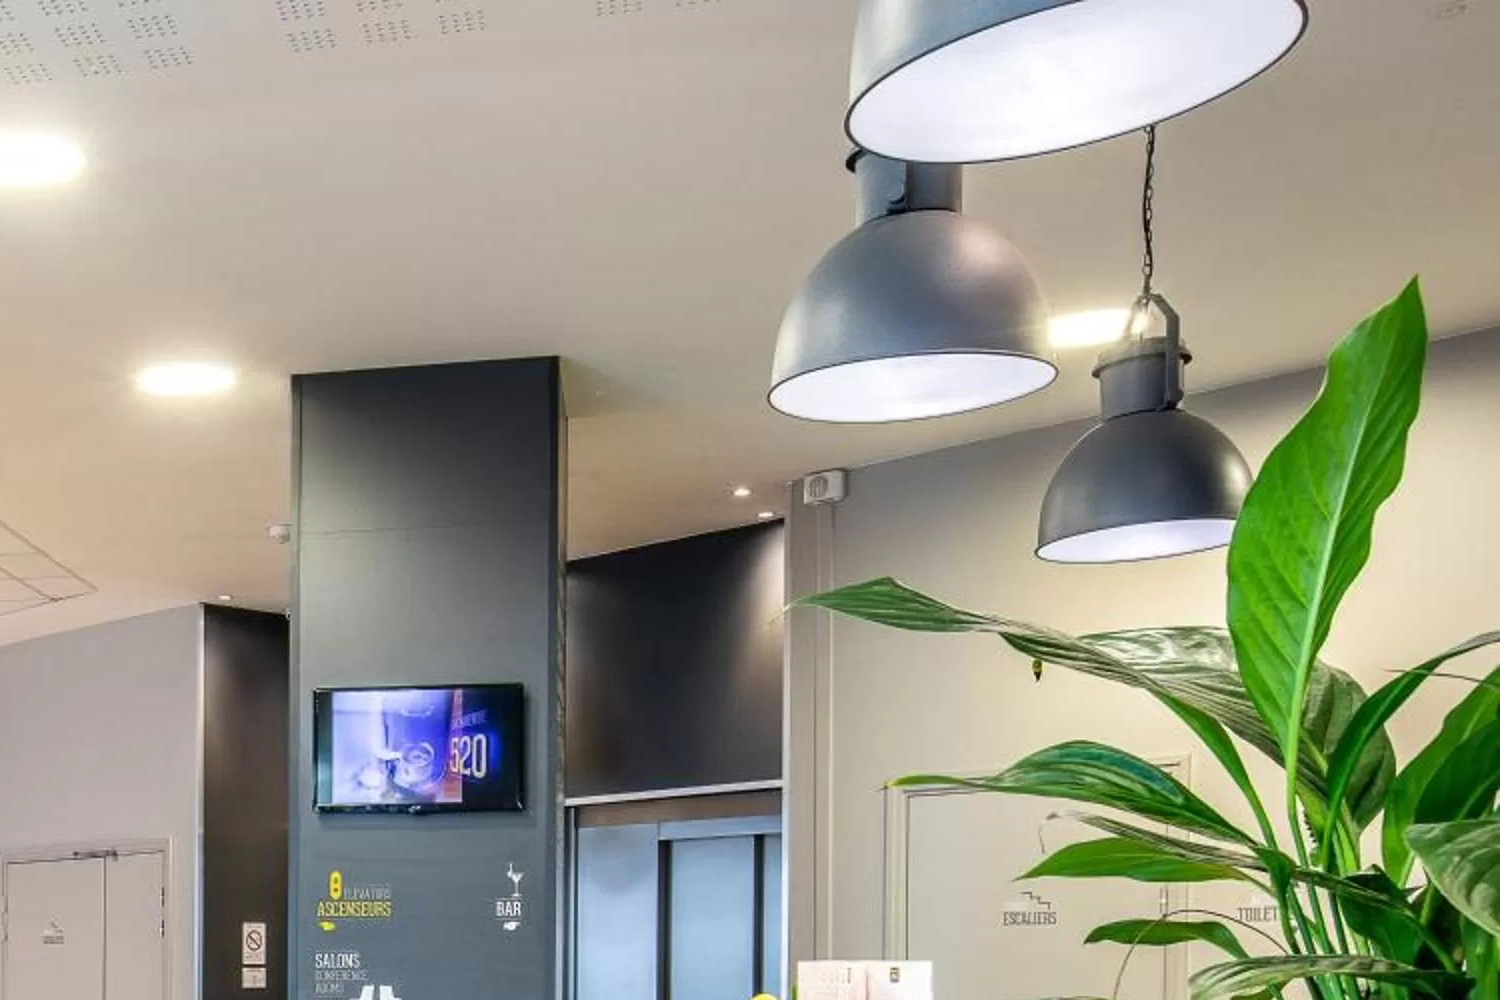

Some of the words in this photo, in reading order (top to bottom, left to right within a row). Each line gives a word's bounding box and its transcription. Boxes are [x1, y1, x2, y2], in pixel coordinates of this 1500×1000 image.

[451, 733, 487, 778] 520
[317, 901, 392, 917] ASCENSEURS
[495, 901, 521, 916] BAR
[1236, 906, 1278, 922] TOILET
[1003, 911, 1057, 926] ESCALIERS
[315, 953, 360, 969] SALONS
